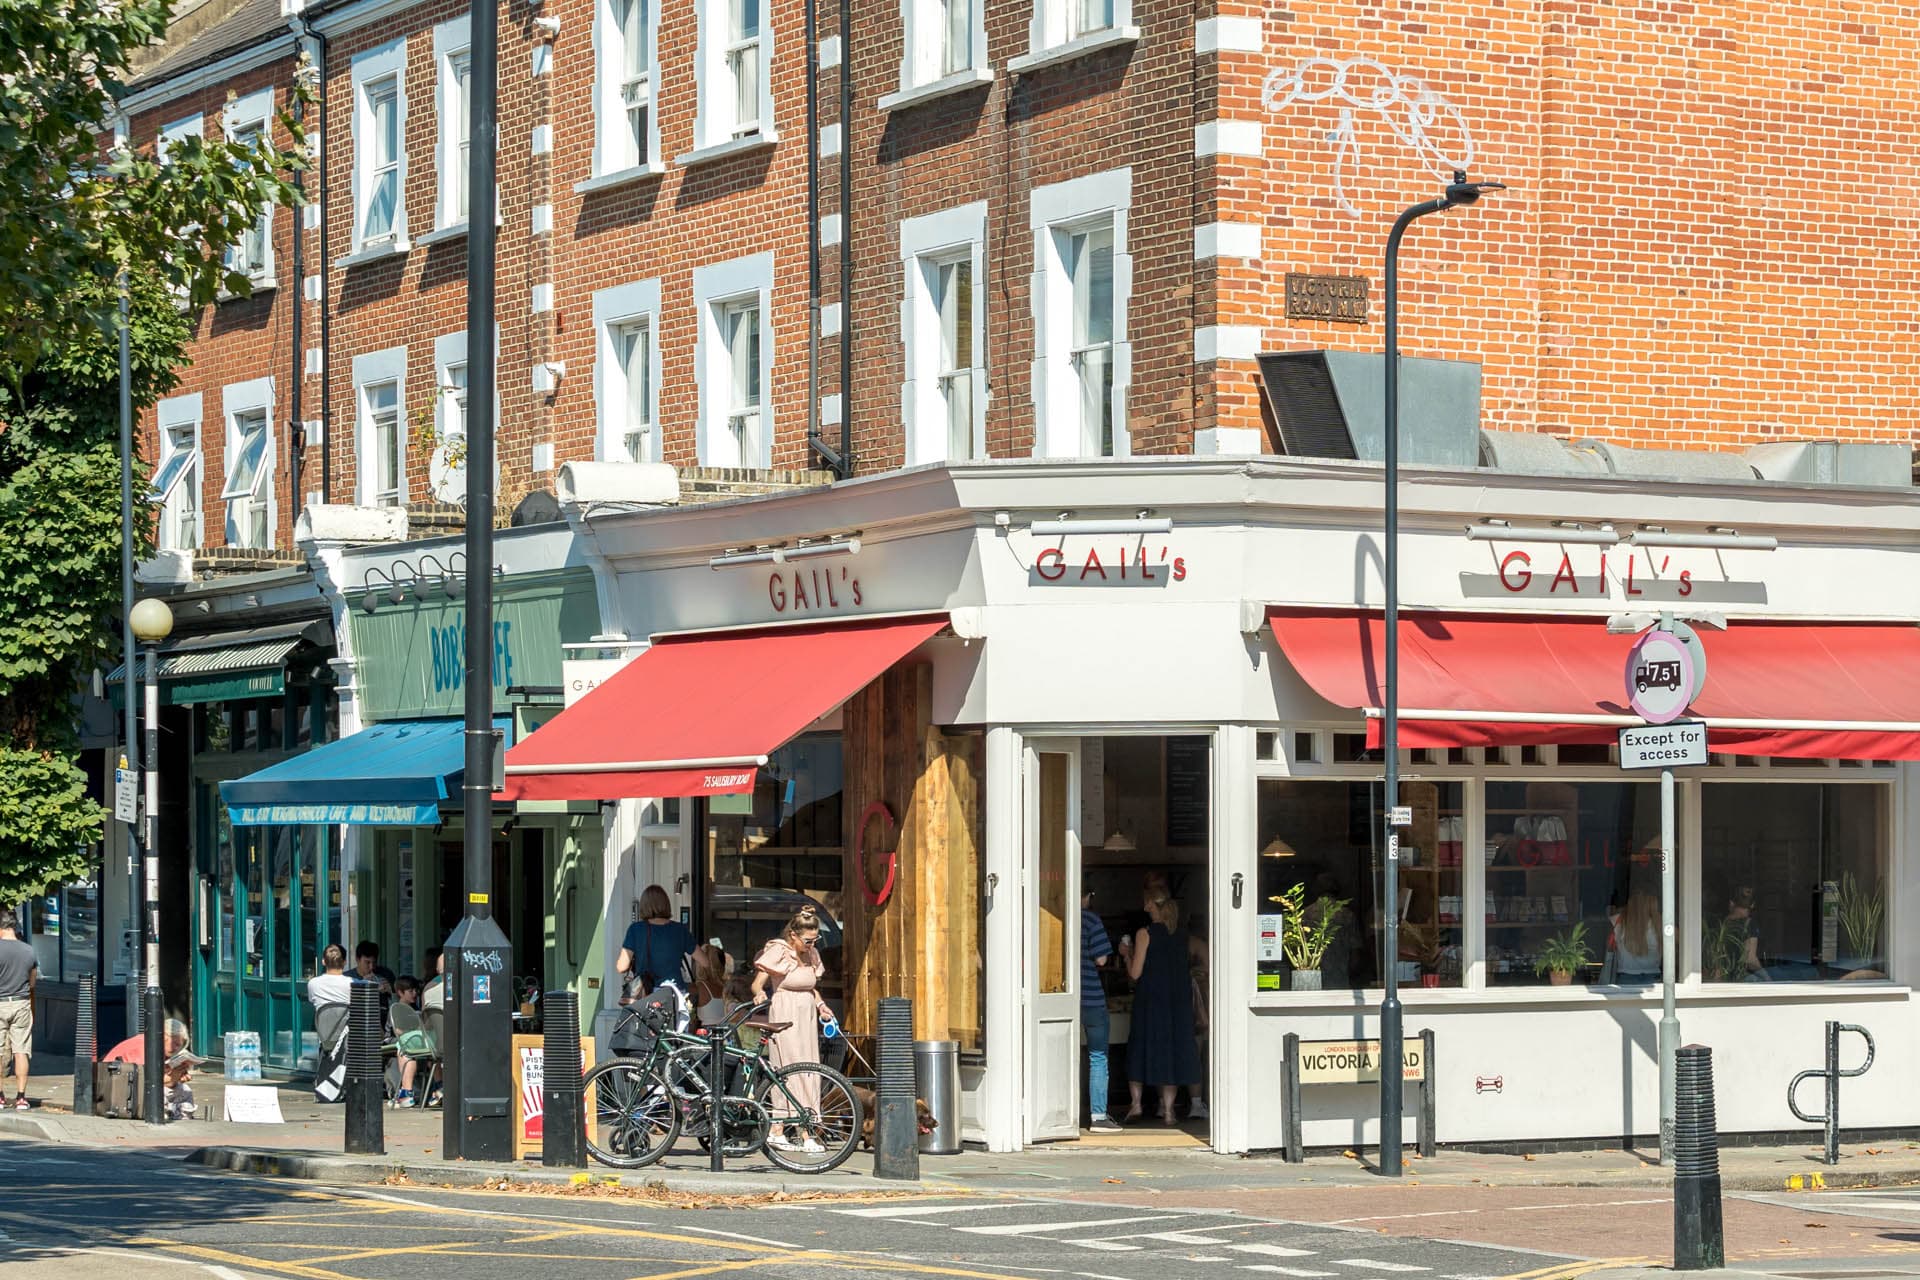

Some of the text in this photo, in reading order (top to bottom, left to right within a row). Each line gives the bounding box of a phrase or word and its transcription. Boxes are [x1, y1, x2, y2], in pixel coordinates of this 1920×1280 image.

[1291, 278, 1366, 299] VICTORIA
[1290, 296, 1332, 315] ROAD
[1036, 546, 1187, 581] GAIL's
[1500, 551, 1693, 596] GAIL's
[769, 566, 862, 612] GAIL's
[1625, 730, 1700, 746] Except for
[1639, 748, 1688, 761] access
[856, 801, 896, 905] G
[1302, 1053, 1373, 1071] VICTORIA
[1402, 1068, 1419, 1078] NW6
